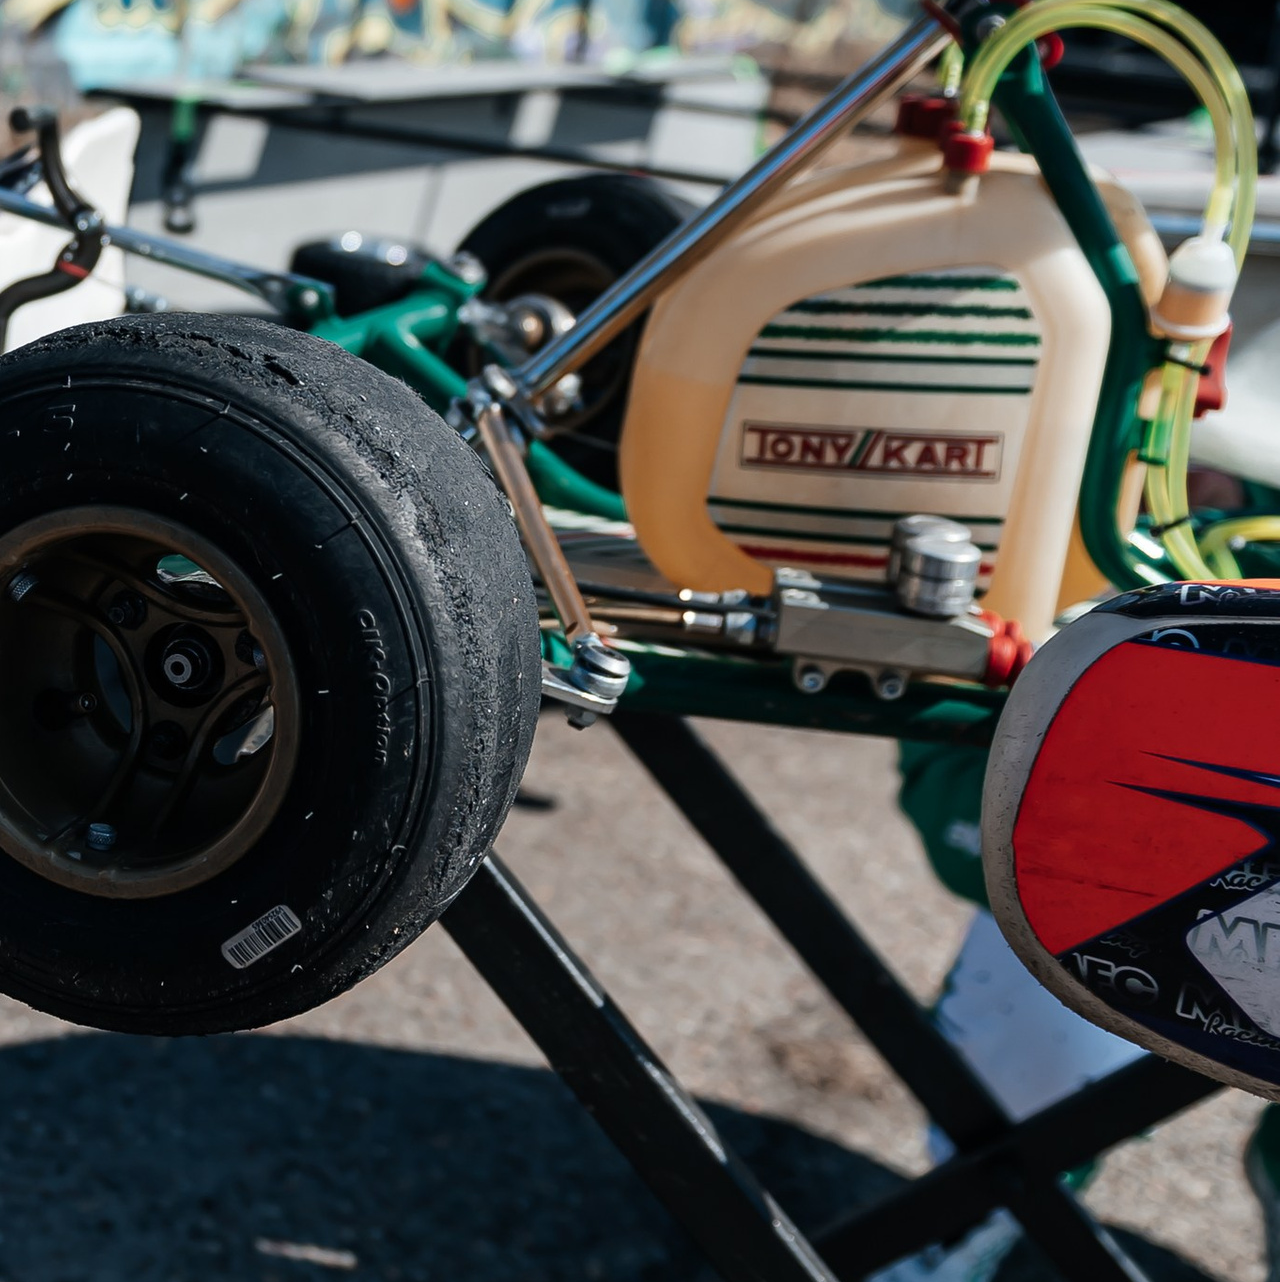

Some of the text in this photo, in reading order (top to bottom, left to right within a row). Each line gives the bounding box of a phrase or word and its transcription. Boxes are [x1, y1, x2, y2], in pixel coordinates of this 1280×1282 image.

[746, 426, 1000, 477] TONY KART
[355, 607, 391, 767] CIK-Option
